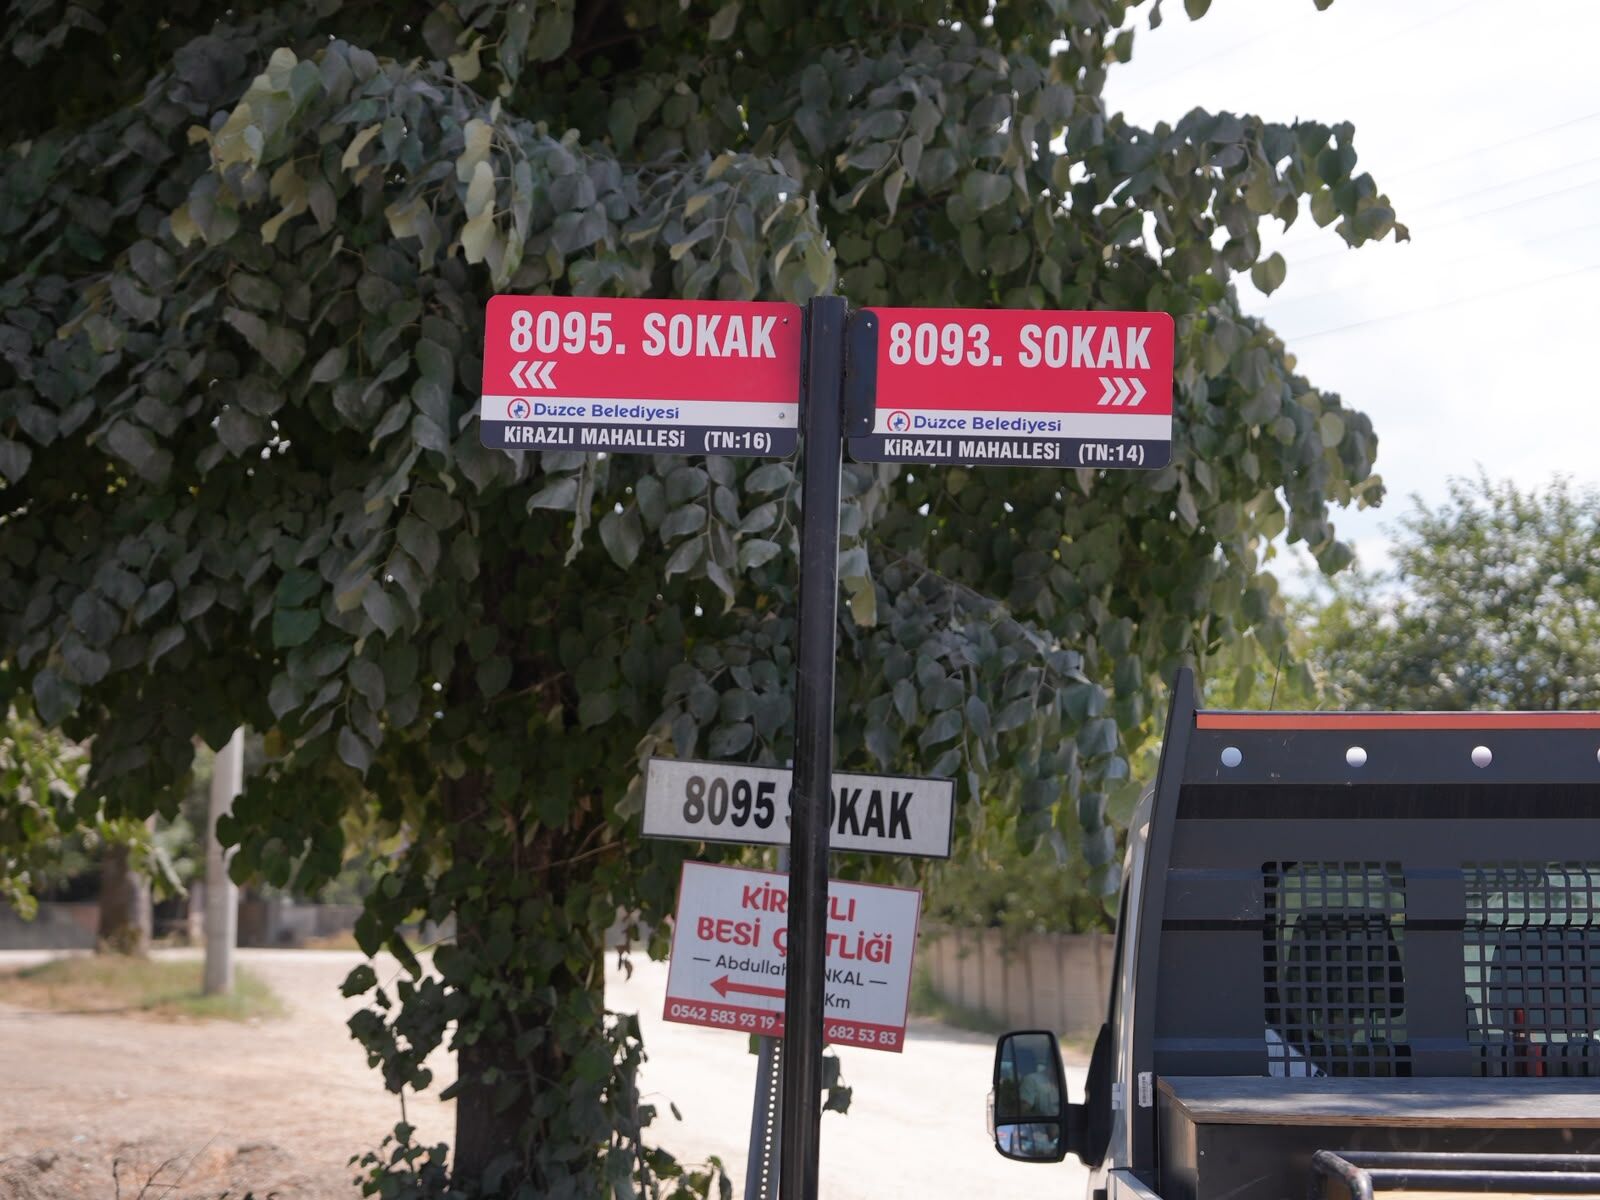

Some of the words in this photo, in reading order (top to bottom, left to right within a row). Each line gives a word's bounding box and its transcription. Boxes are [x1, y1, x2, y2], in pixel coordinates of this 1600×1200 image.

[509, 309, 626, 355] 8095.
[642, 312, 778, 358] SOKAK
[889, 322, 1003, 367] 8093.
[1018, 324, 1152, 369] SOKAK
[533, 402, 585, 417] Düzce
[591, 403, 680, 421] Belediyesi
[914, 415, 966, 430] Düzce
[972, 416, 1062, 434] Belediyesi
[704, 431, 772, 453] (TN:16)
[1078, 444, 1145, 466] (TN:14)
[683, 775, 776, 830] 8095
[785, 787, 914, 840] KAK
[742, 881, 856, 922] KİRLI
[697, 916, 761, 948] BESİ
[772, 927, 893, 965] ÇTLİĞİ
[825, 993, 850, 1009] Km
[670, 1004, 707, 1021] 0542
[710, 1009, 737, 1024] 583
[739, 1013, 756, 1027] 93
[759, 1015, 775, 1029] 19
[828, 1024, 855, 1040] 682
[858, 1029, 876, 1043] 53
[878, 1031, 897, 1045] 83
